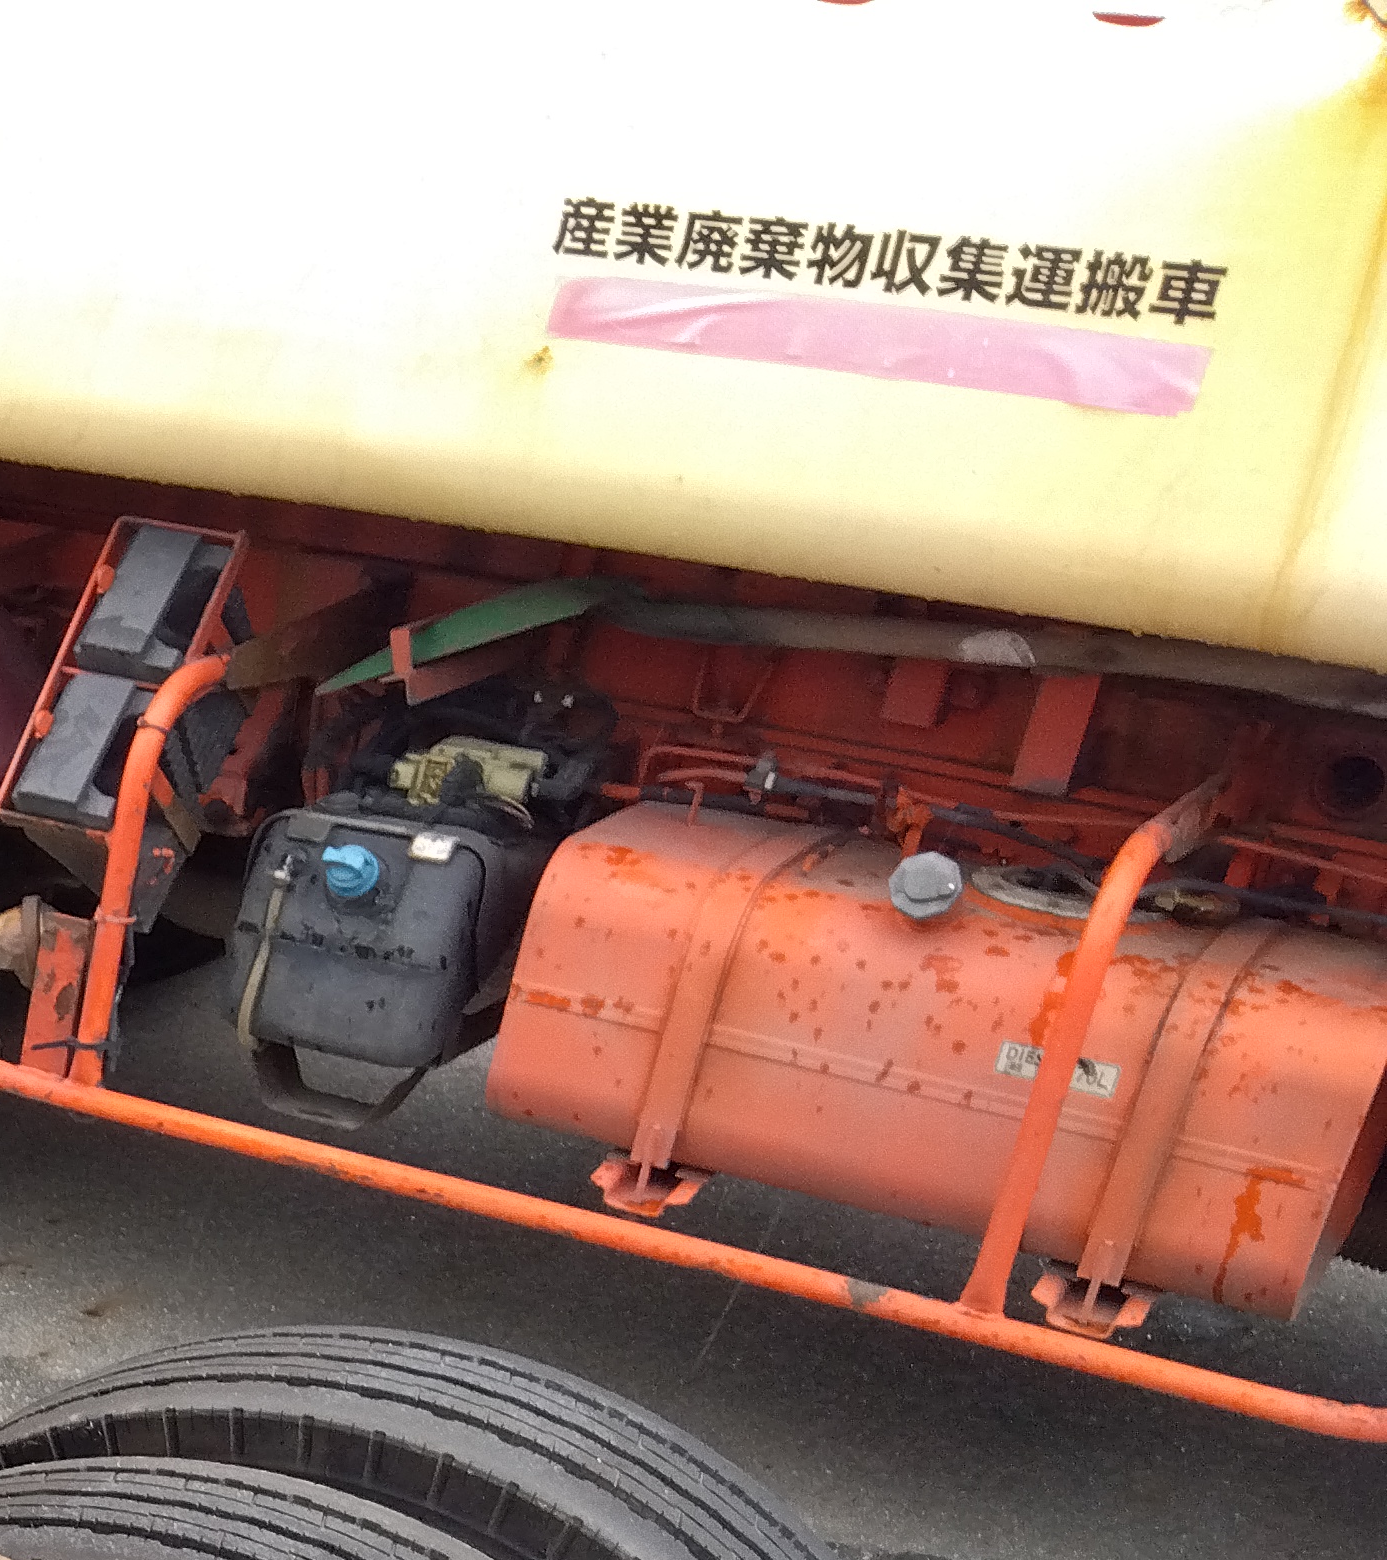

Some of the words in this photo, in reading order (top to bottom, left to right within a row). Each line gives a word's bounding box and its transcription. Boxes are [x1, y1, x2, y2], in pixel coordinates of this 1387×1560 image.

[552, 197, 1228, 326] 産業廃棄物収集運搬車
